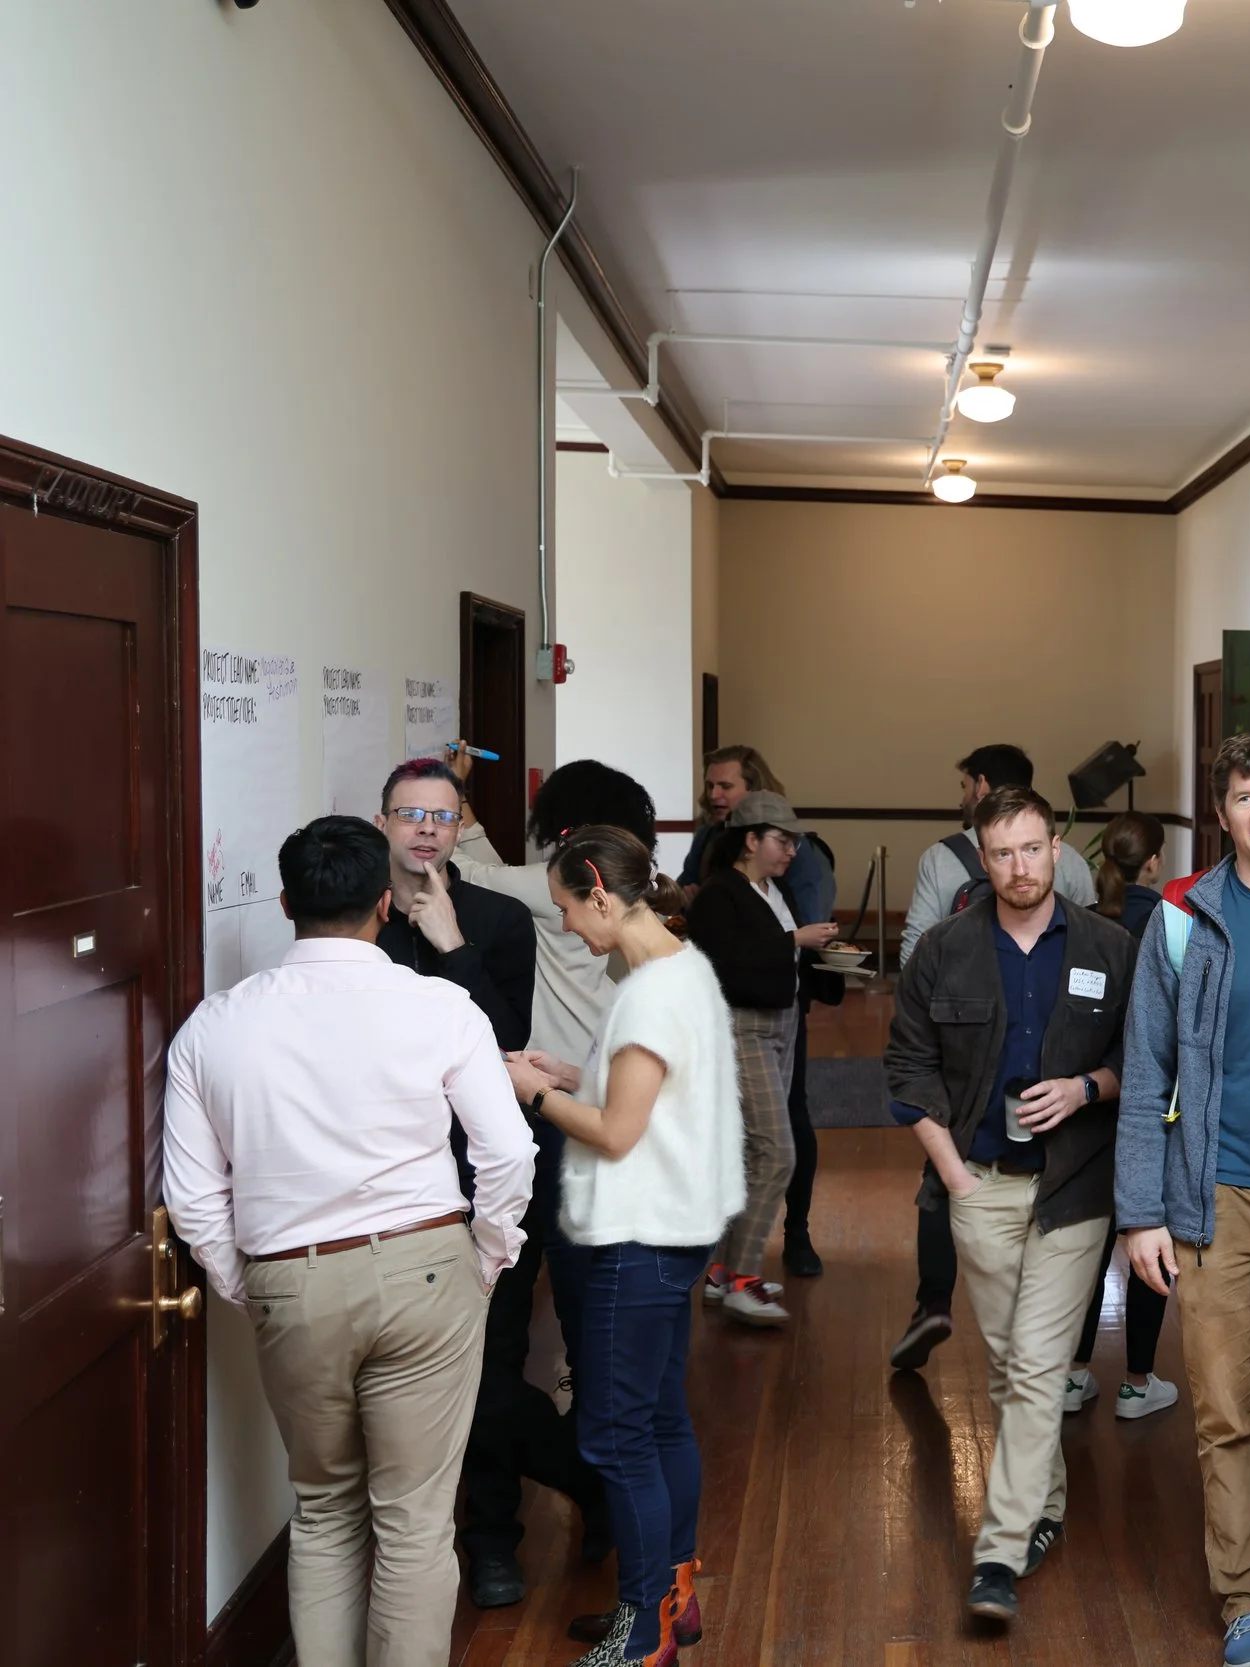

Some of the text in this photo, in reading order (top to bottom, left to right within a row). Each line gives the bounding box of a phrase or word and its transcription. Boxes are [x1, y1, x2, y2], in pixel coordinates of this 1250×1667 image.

[203, 648, 229, 685] PROJECT
[202, 692, 226, 723] PROJECT
[207, 871, 259, 907] NAME EMAIL
